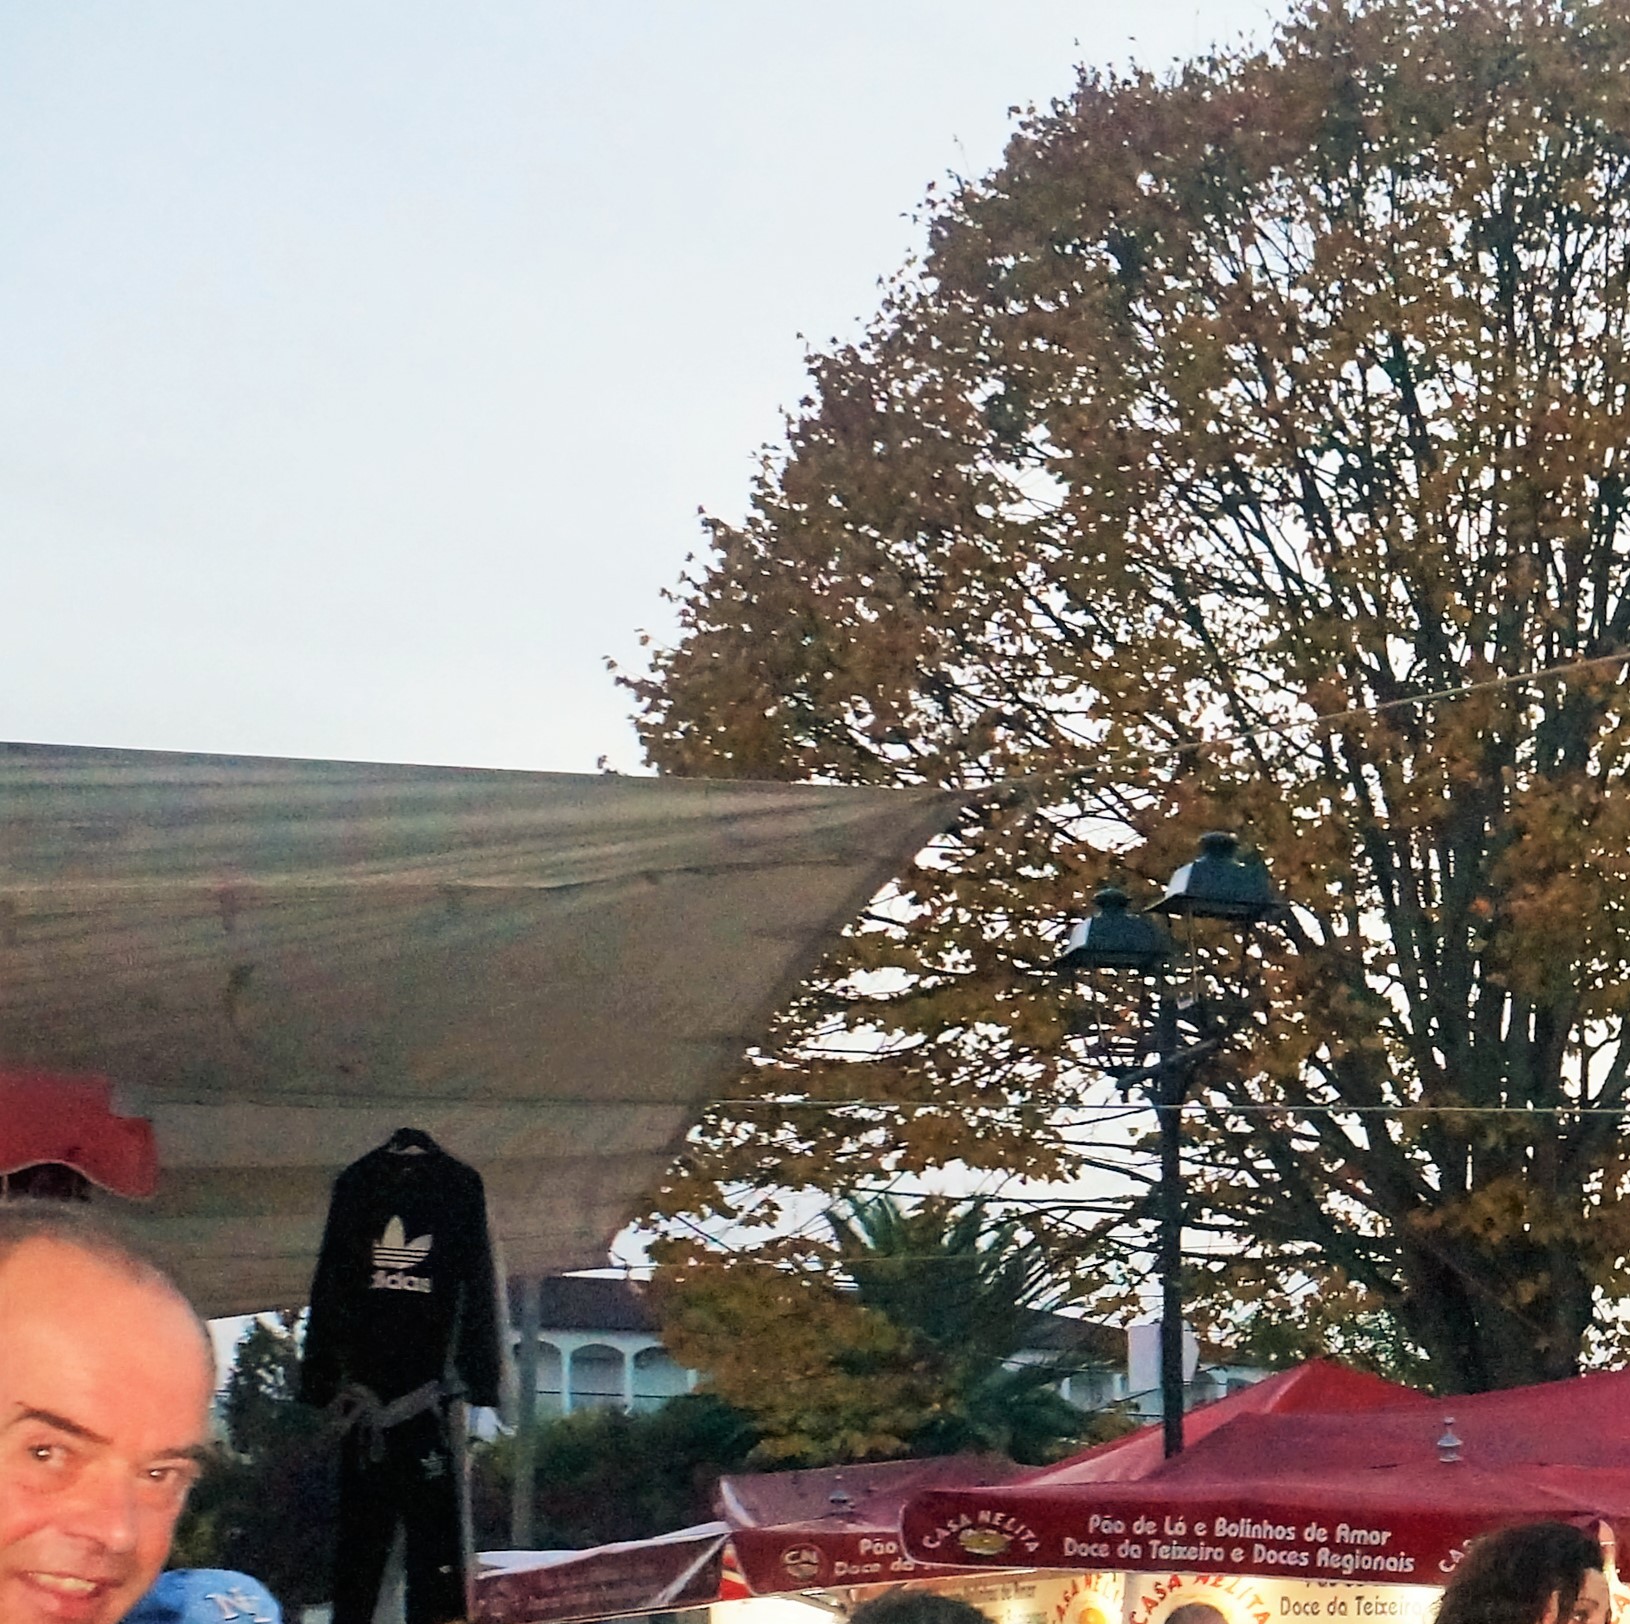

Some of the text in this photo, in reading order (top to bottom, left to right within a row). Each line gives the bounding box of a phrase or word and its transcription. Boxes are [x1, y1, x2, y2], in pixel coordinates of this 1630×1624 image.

[922, 1509, 1040, 1552] CASA NELITA
[1088, 1514, 1392, 1546] Pão de Ló e Bolinhos de Amor
[858, 1537, 898, 1556] Pão
[1064, 1537, 1416, 1575] Doce da Teixeira e Doces Regionais
[1280, 1596, 1321, 1617] Doce
[1326, 1595, 1348, 1617] da
